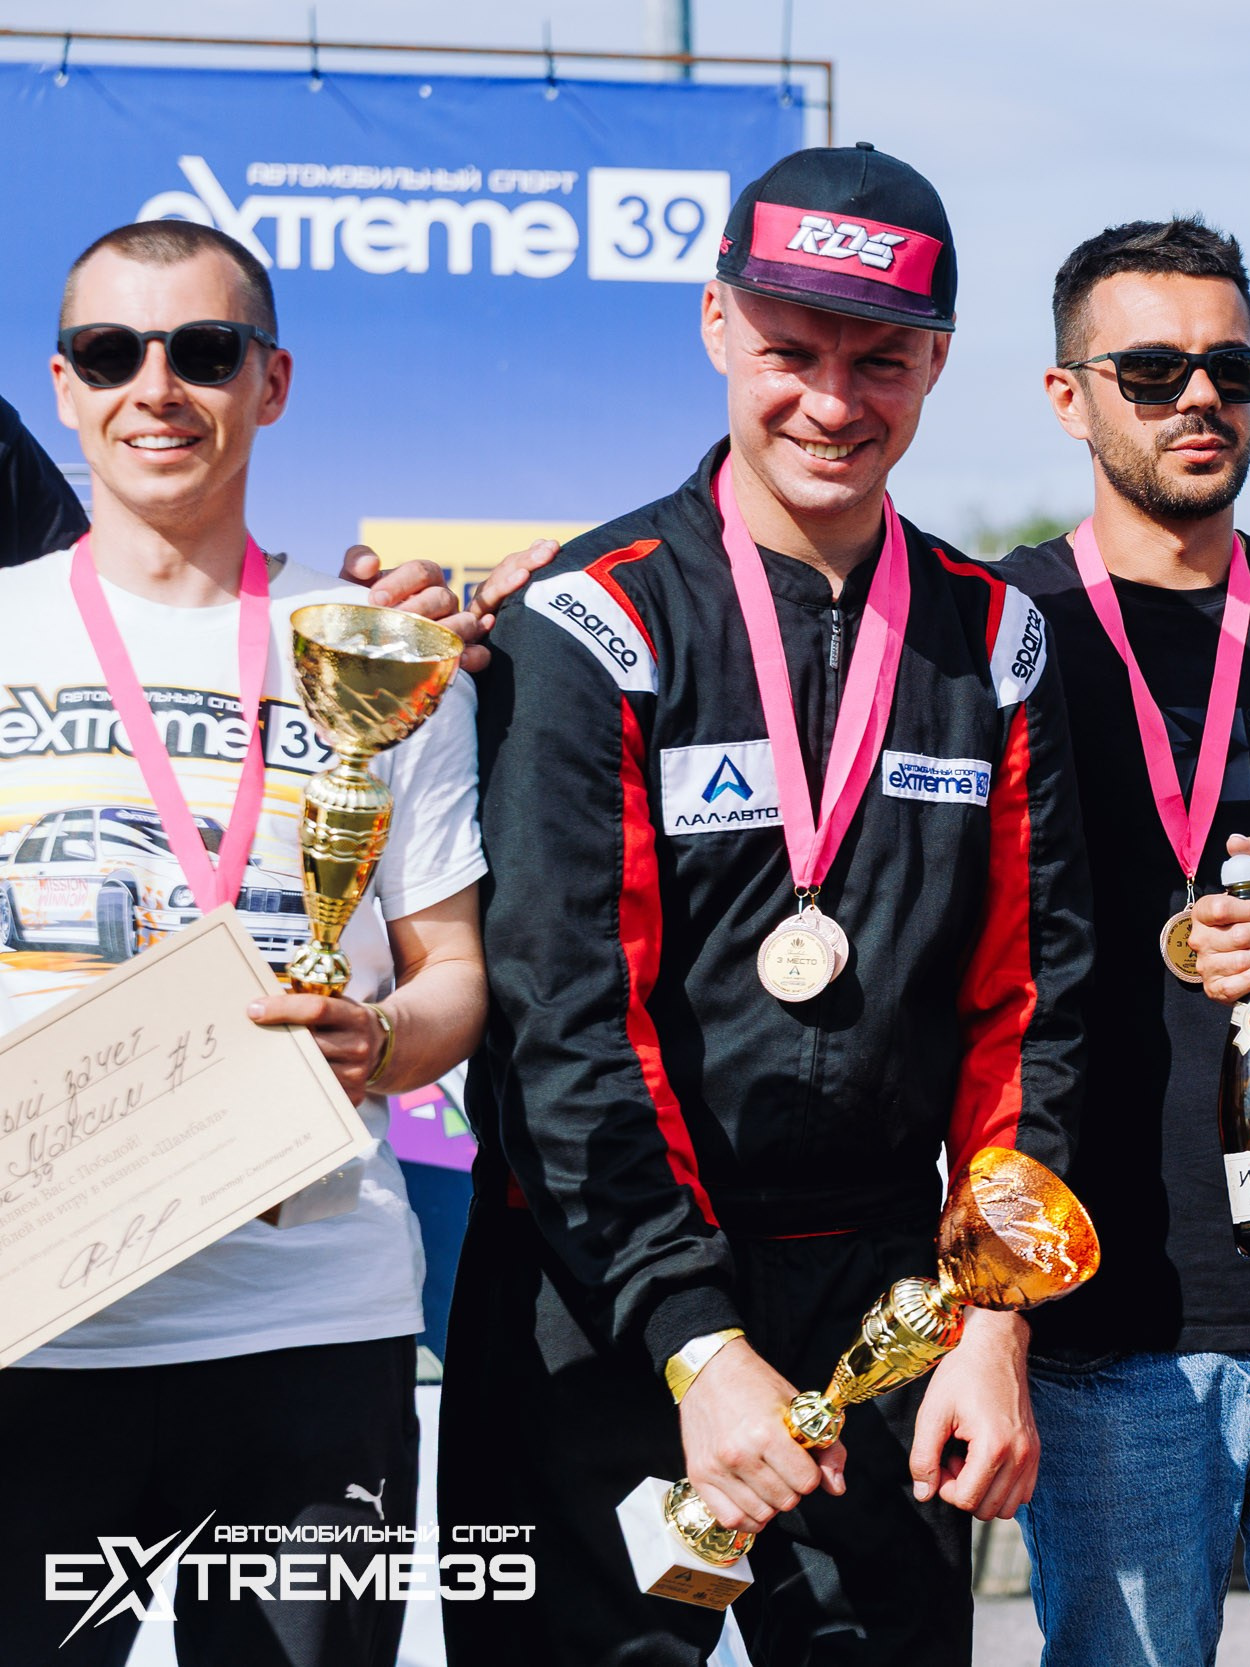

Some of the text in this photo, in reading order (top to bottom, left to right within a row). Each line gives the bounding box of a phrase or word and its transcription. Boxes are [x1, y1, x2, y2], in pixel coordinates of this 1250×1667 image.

[247, 161, 579, 195] АВТОМОБИЛЬНЫЙ СПОРТ
[613, 196, 703, 261] 39
[786, 215, 908, 270] RDS
[550, 592, 638, 672] sparco
[60, 690, 262, 713] АВТОМЛЬНЫЙ СПО
[281, 719, 337, 764] 39
[674, 806, 780, 827] ЛАЛ-АВТО
